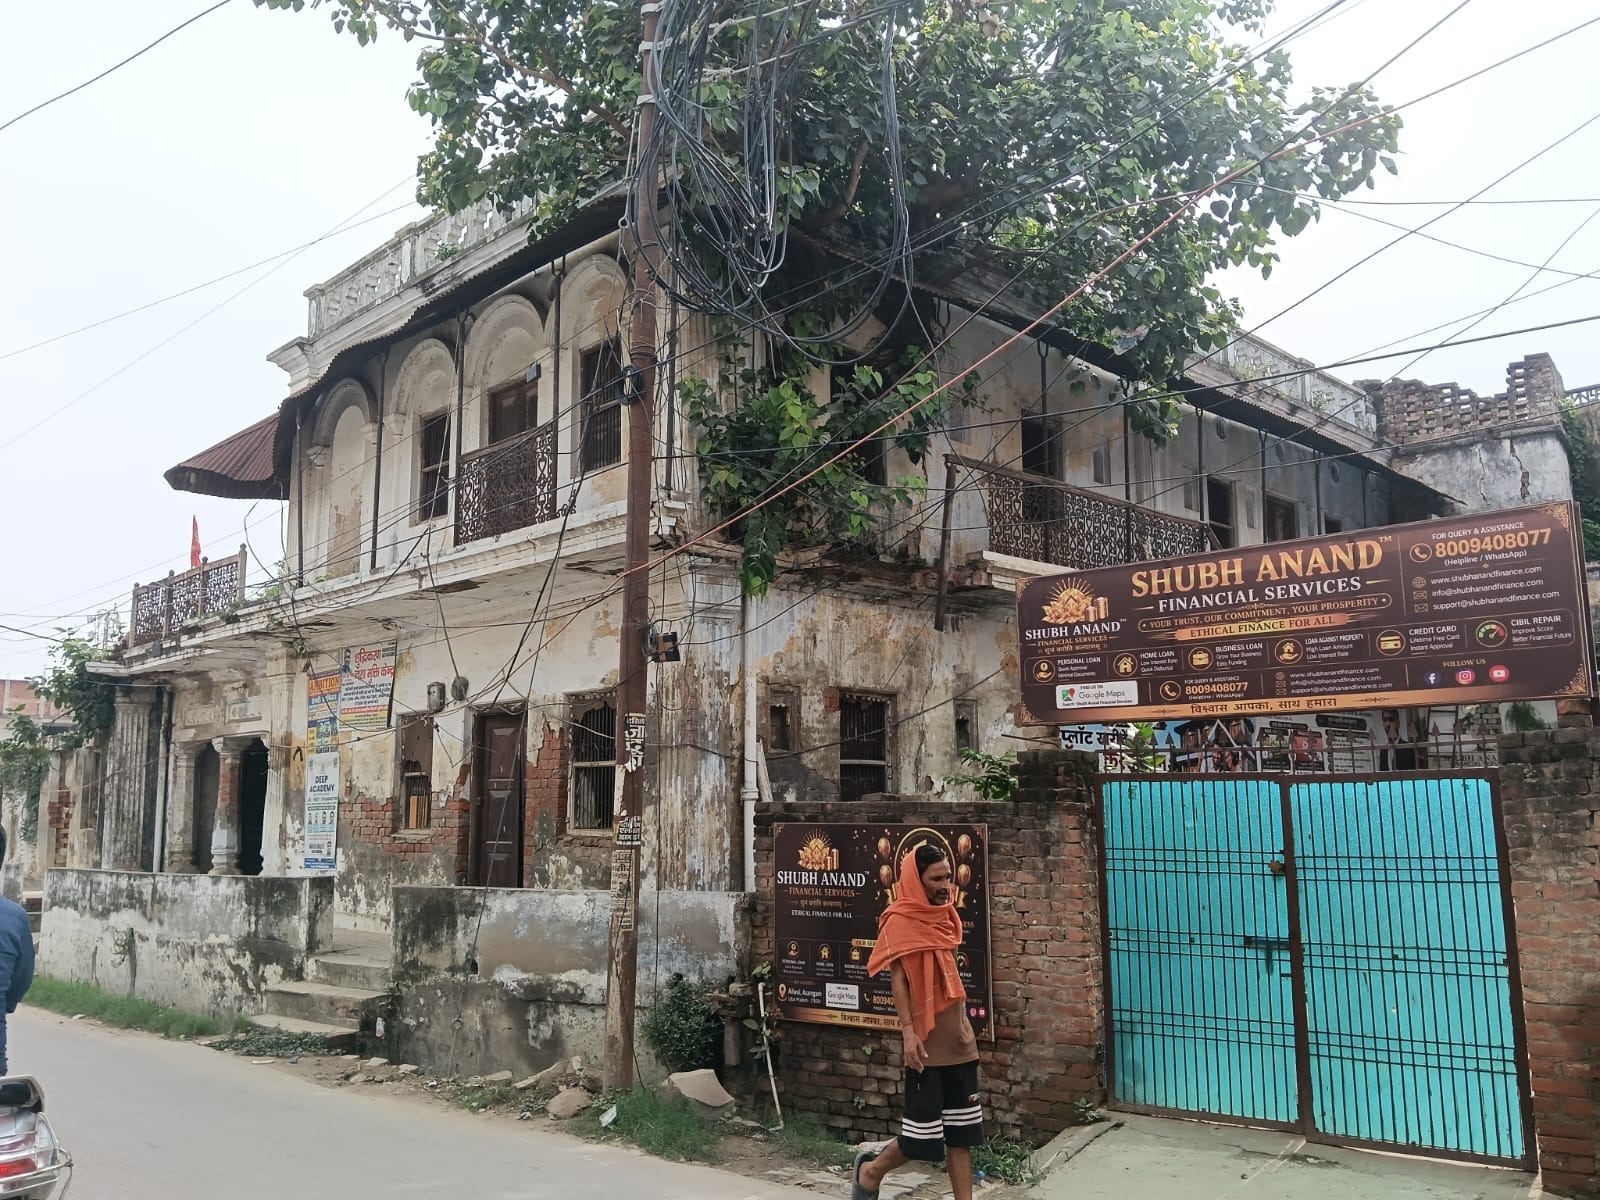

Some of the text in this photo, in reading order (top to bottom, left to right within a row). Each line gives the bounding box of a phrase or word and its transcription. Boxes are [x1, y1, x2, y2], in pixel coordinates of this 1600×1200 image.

[1432, 521, 1525, 540] FOR QUERY & ASSISTANCE
[1435, 527, 1551, 558] 8009408077
[1444, 555, 1479, 567] (Helpline
[1485, 550, 1528, 562] WhatsApp)
[1131, 558, 1245, 598] SHUBH
[1256, 540, 1384, 582] ANAND
[1430, 565, 1542, 585] www.shubhanandfinance.com
[1432, 578, 1544, 597] info@shubhanandfinance.com
[1159, 576, 1362, 613] FINANCIAL SERVICES
[1433, 590, 1560, 611] support@shubhanandfinance.com
[1150, 597, 1379, 629] YOUR TRUST, OUR COMMITMENT, YOUR PROSPERITY
[1190, 615, 1335, 638] ETHICAL FINANCE FOR ALL
[1511, 615, 1561, 626] CIBIL REPAIR
[1025, 625, 1068, 640] SHUBH
[1073, 621, 1121, 636] ANAND
[1409, 625, 1457, 636] CREDIT CARD
[1512, 625, 1554, 636] Improve Score
[1512, 631, 1572, 643] Better Financial Future
[1037, 635, 1108, 647] FINANCIAL SERVICES
[1318, 636, 1339, 644] AGAINST
[1339, 633, 1364, 642] PROPERTY
[1215, 642, 1263, 653] BUSINESS LOAN
[1429, 642, 1453, 651] Approval
[1057, 658, 1085, 666] PERSONAL
[1443, 659, 1475, 668] FOLLOW
[309, 675, 341, 691] AMBITION
[1185, 682, 1249, 695] 8009408077
[1079, 690, 1125, 700] Google Maps
[1190, 698, 1337, 714] विश्वास आपका, साथ हमारा
[1060, 726, 1093, 745] प्लॉट
[315, 775, 329, 784] DEEP
[309, 784, 335, 793] ACADEMY
[777, 870, 818, 885] SHUBH
[821, 872, 866, 887] ANAND
[789, 887, 855, 897] FINANCIAL SERVICES
[827, 990, 845, 1000] Google
